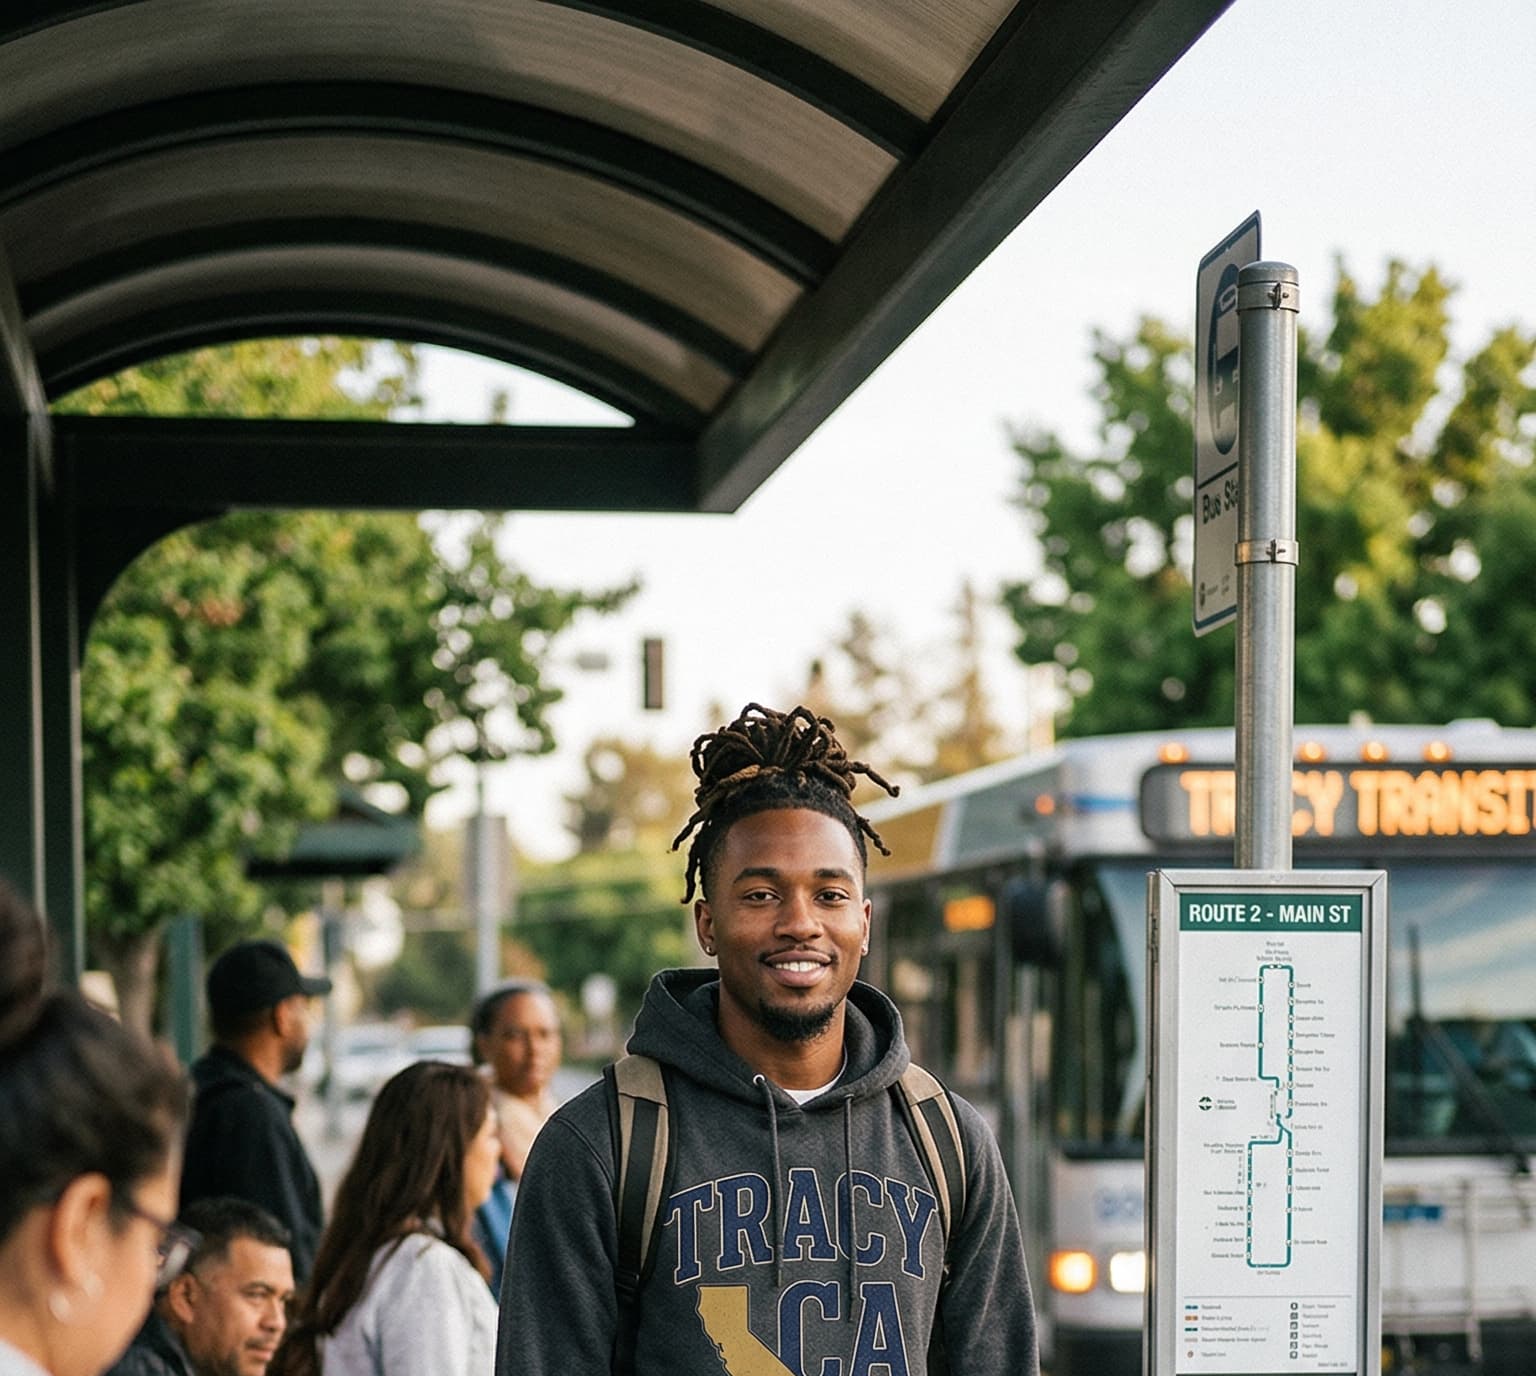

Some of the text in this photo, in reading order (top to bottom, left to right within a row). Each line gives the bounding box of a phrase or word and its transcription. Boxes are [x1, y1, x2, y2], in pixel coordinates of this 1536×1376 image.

[1203, 494, 1221, 524] Bus
[1189, 904, 1246, 923] ROUTE
[1250, 905, 1262, 923] 2
[1279, 905, 1325, 923] MAIN
[1329, 905, 1352, 924] ST
[664, 1167, 938, 1285] TRACY
